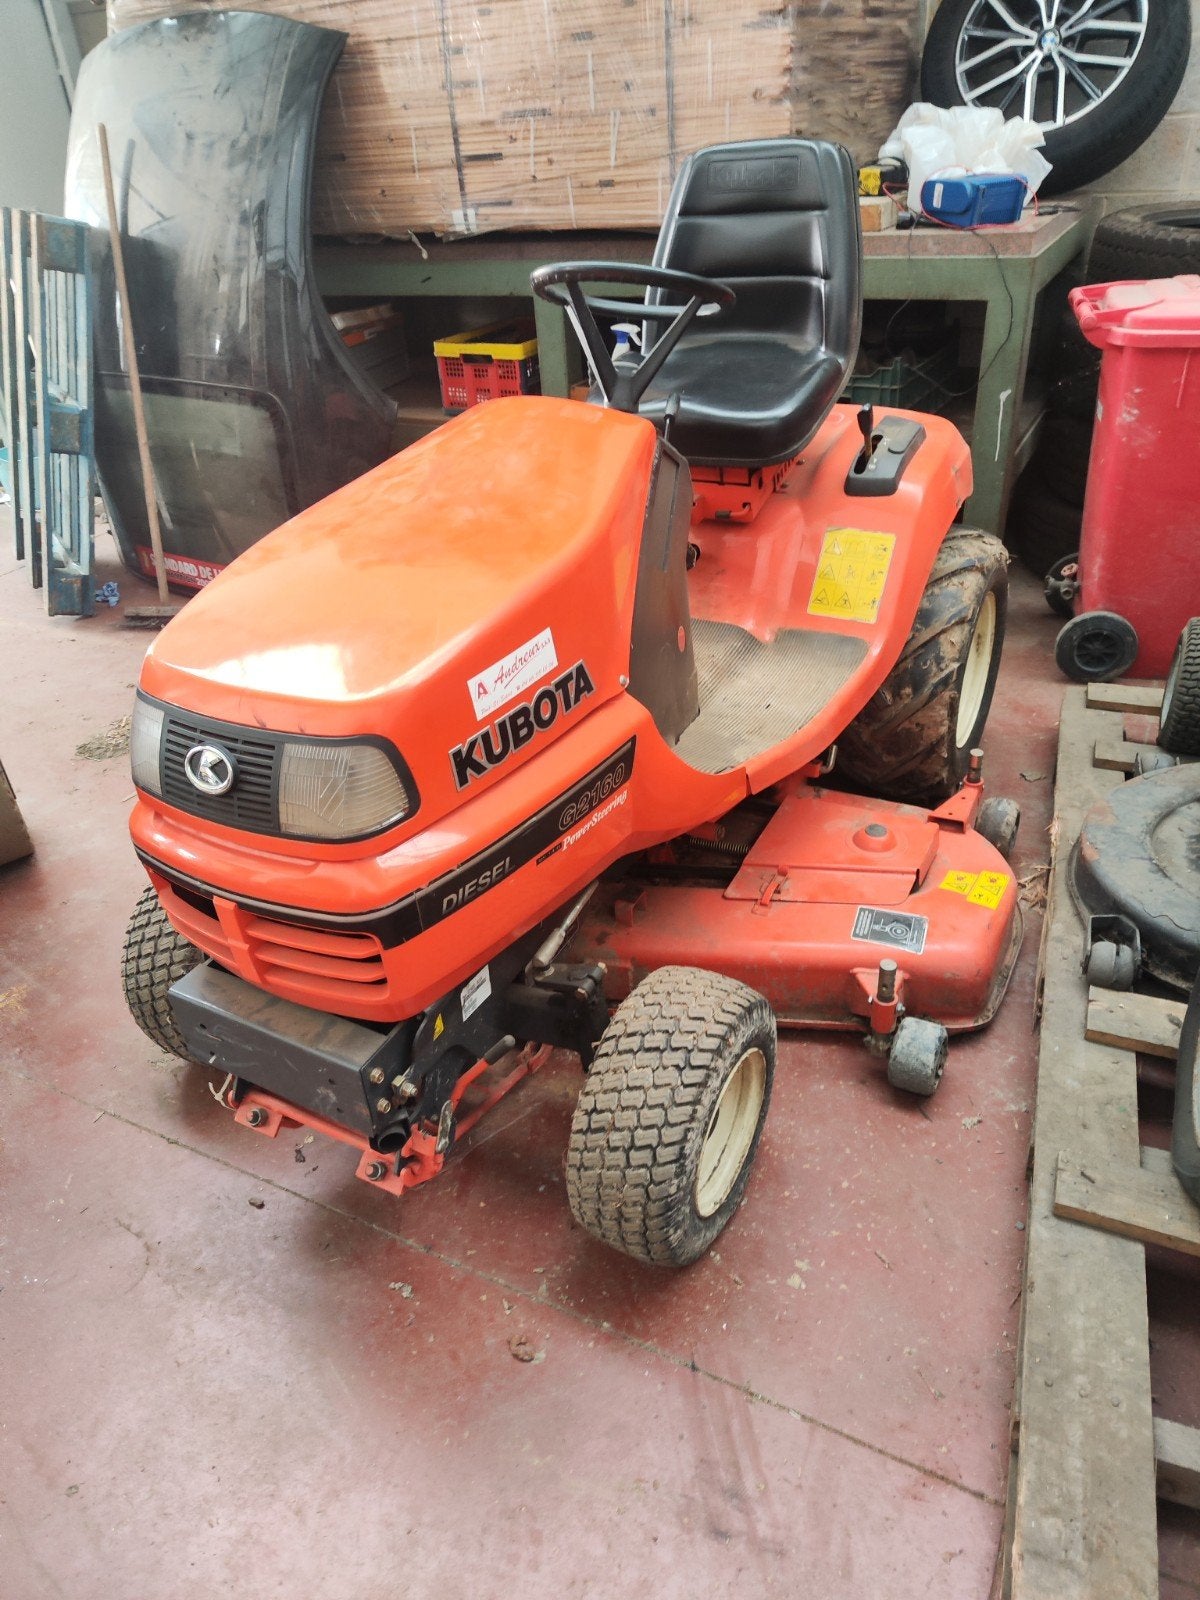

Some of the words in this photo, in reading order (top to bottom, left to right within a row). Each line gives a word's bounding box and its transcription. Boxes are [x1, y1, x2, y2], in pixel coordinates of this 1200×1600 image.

[450, 660, 595, 790] KUBOTA
[558, 762, 625, 831] G2160
[442, 856, 516, 915] DIESEL
